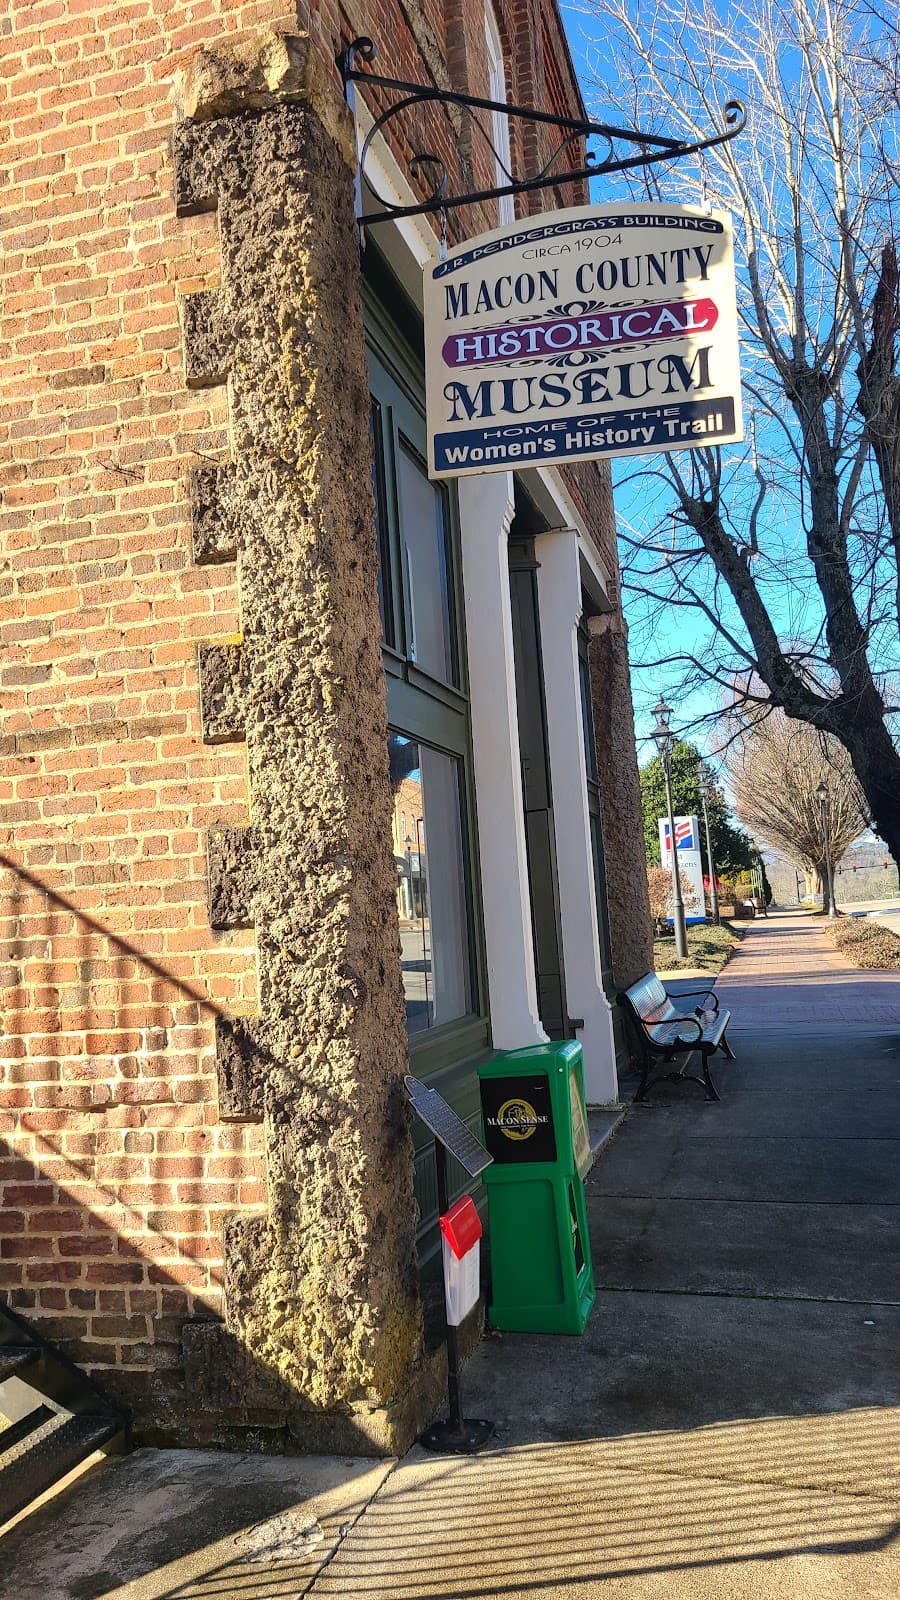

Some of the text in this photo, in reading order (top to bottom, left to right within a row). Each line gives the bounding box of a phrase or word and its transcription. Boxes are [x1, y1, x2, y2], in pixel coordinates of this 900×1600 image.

[472, 217, 618, 259] PENDERGRASS
[623, 216, 717, 231] BUILDING
[522, 233, 623, 260] CIRCA 1904
[444, 244, 714, 321] MACON COUNTY
[455, 304, 709, 363] HISTORICAL
[443, 345, 715, 422] MUSEUM
[444, 413, 723, 464] Women's History Trail
[483, 407, 681, 440] HOME OF THE
